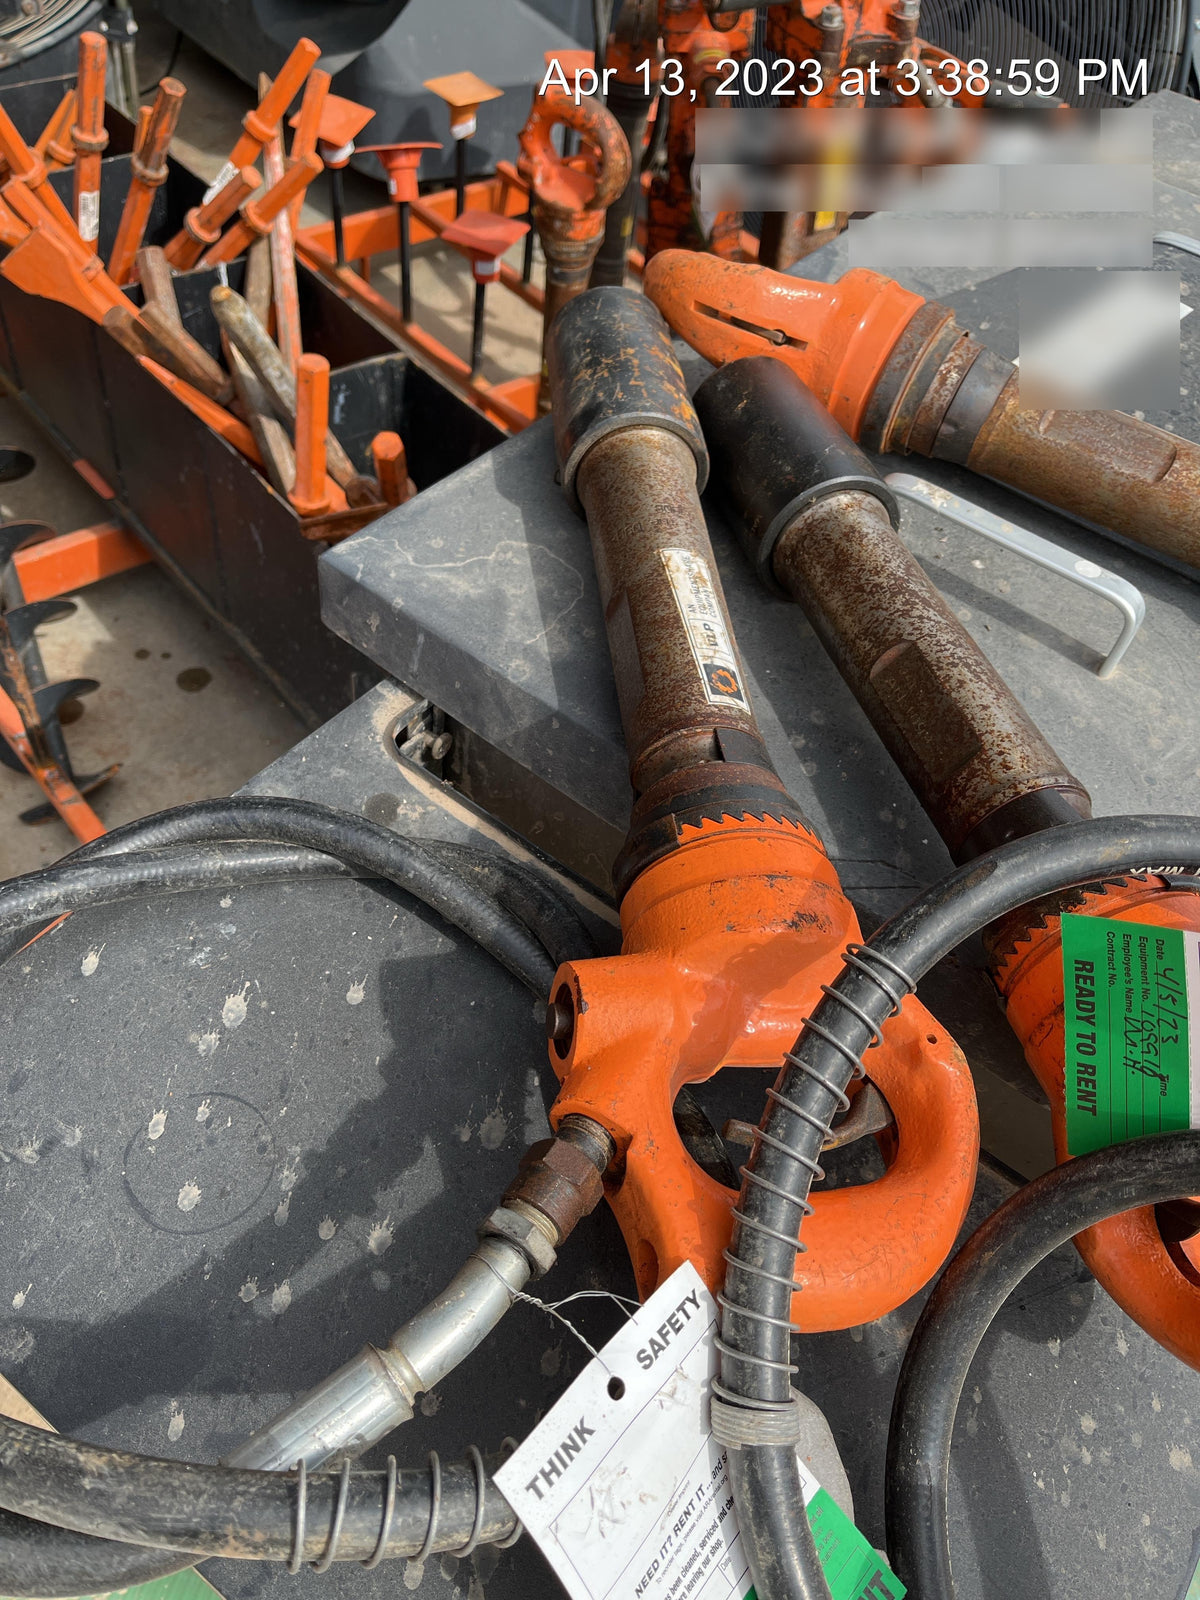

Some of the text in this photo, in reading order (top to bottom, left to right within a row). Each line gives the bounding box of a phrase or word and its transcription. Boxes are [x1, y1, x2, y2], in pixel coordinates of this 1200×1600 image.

[1106, 931, 1117, 987] Contract No.
[1122, 934, 1134, 1013] Employee's Name
[1139, 936, 1150, 1002] Equipment No.
[1156, 939, 1165, 960] Date
[1074, 960, 1097, 1116] READY TO RENT
[636, 1288, 701, 1371] SAFETY
[525, 1415, 597, 1501] THINK
[635, 1559, 659, 1598] NEED
[660, 1535, 672, 1560] IT?
[673, 1498, 695, 1537] RENT
[712, 1459, 723, 1479] and
[669, 1576, 682, 1595] been
[681, 1548, 701, 1578] cleaned,
[699, 1520, 719, 1550] serviced
[717, 1506, 727, 1523] and
[683, 1522, 696, 1542] please
[720, 1556, 732, 1571] Date
[684, 1567, 704, 1593] leaving
[702, 1554, 711, 1569] our
[710, 1538, 723, 1556] shop.
